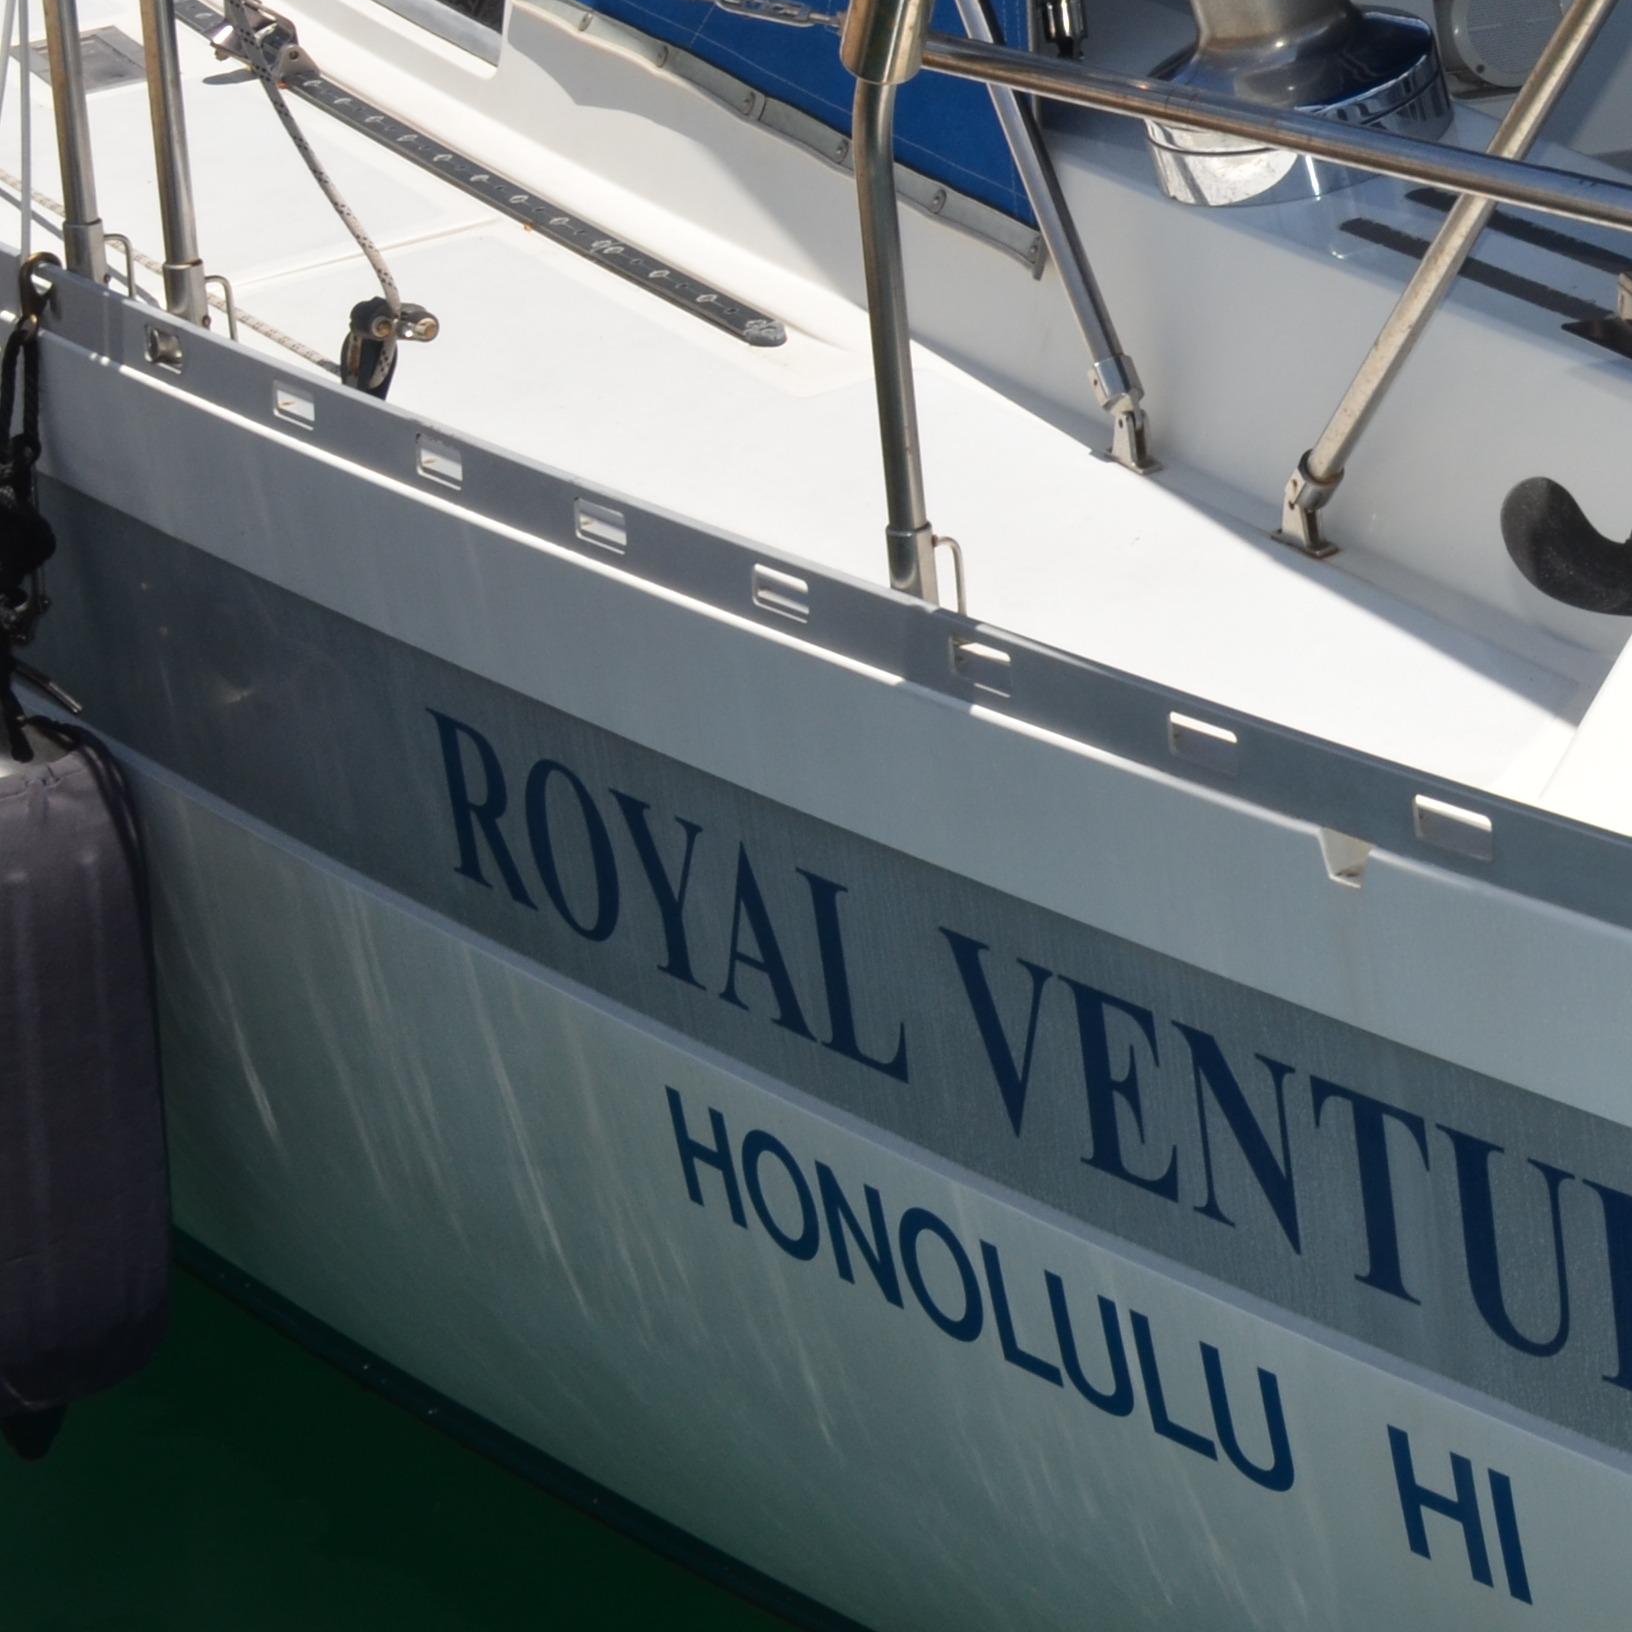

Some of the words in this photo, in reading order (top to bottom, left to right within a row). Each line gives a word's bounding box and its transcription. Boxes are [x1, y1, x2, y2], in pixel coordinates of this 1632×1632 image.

[425, 707, 910, 1085] ROYAL
[664, 1085, 1296, 1494] HONOLULU
[1386, 1423, 1534, 1607] HI
